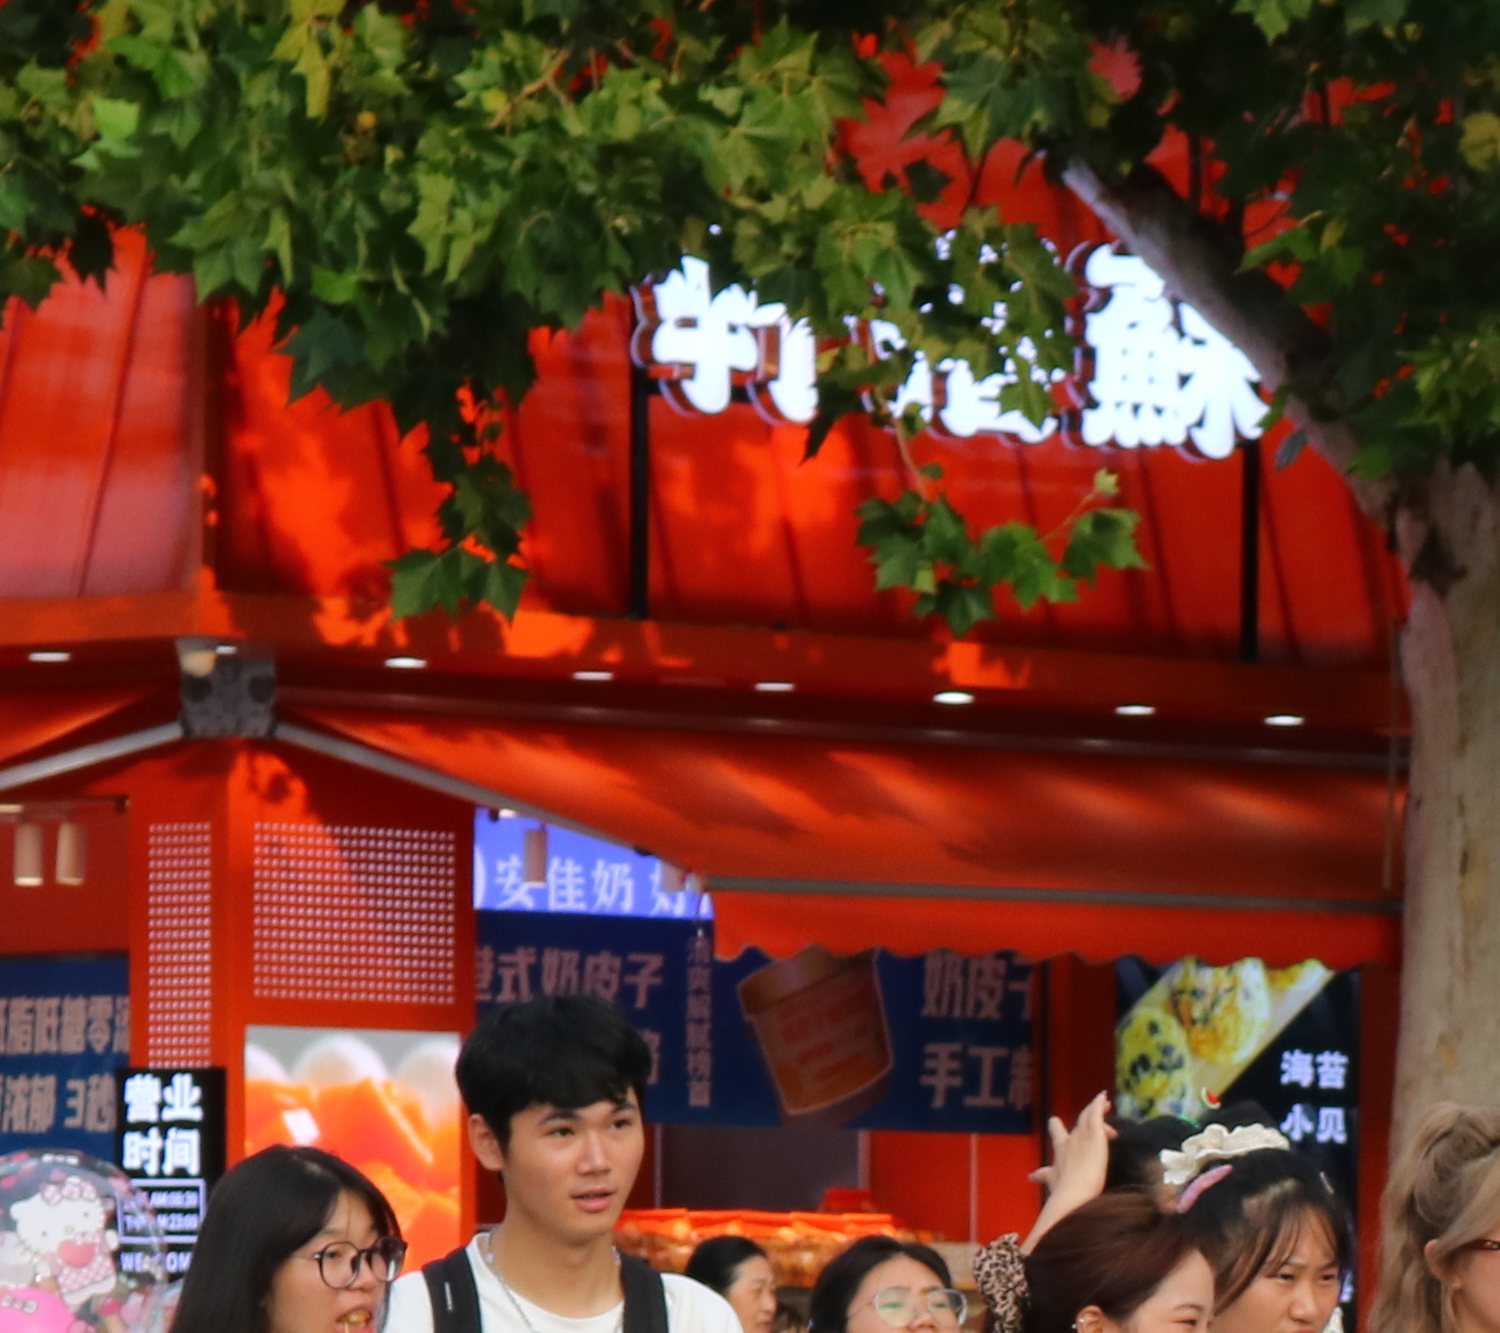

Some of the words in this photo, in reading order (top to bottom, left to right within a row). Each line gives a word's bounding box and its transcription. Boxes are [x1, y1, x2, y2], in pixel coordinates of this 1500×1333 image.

[1279, 1049, 1348, 1092] 海苔
[123, 1072, 205, 1124] 营业
[1279, 1106, 1347, 1146] 小贝
[121, 1127, 202, 1177] 时间
